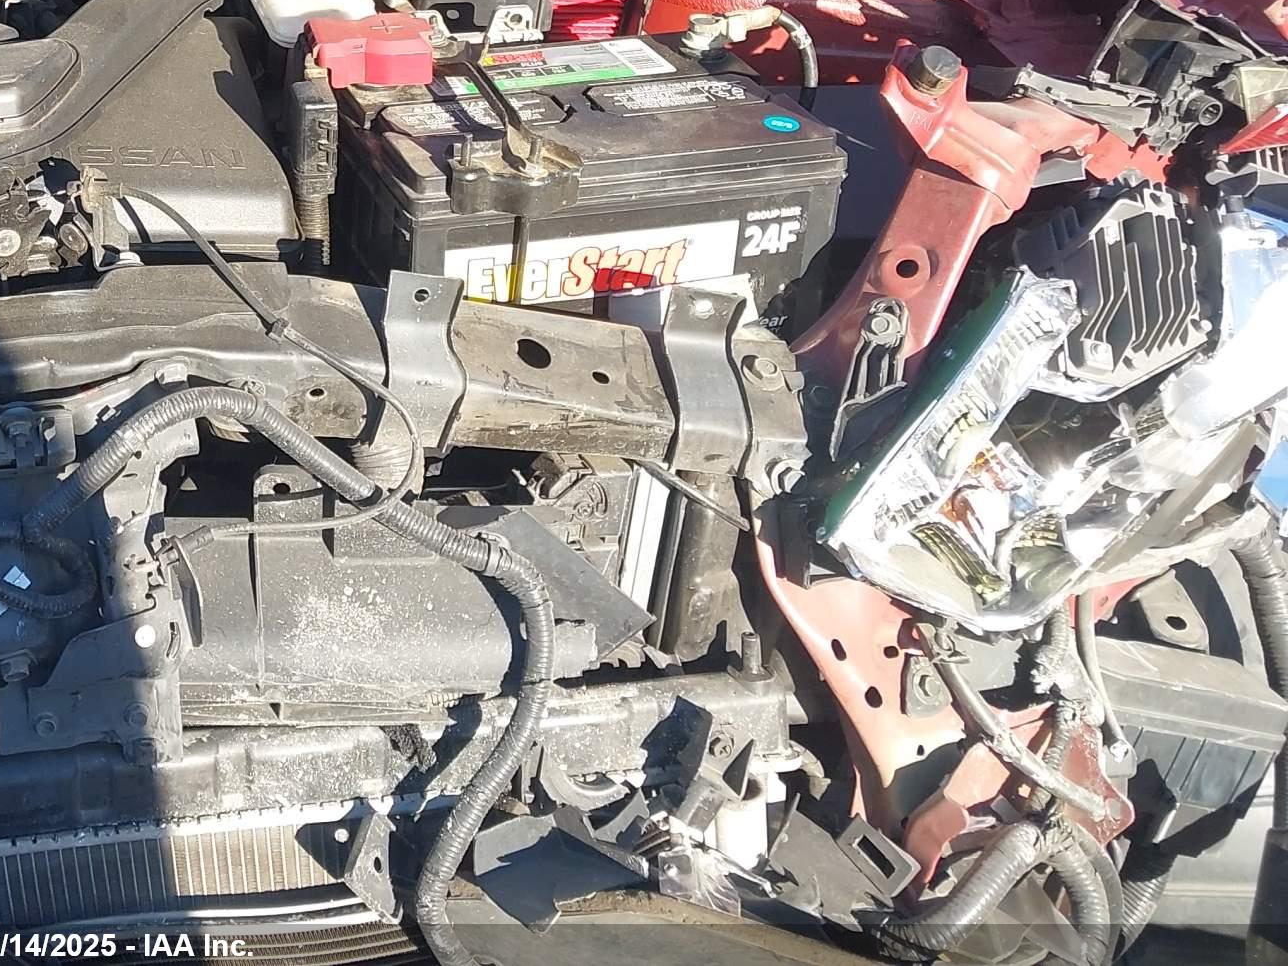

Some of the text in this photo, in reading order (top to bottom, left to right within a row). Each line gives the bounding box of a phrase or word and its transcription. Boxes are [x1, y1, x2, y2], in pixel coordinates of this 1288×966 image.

[747, 208, 781, 221] GROUP
[742, 221, 801, 257] 24F
[467, 238, 688, 304] EverStart
[759, 315, 789, 328] ear
